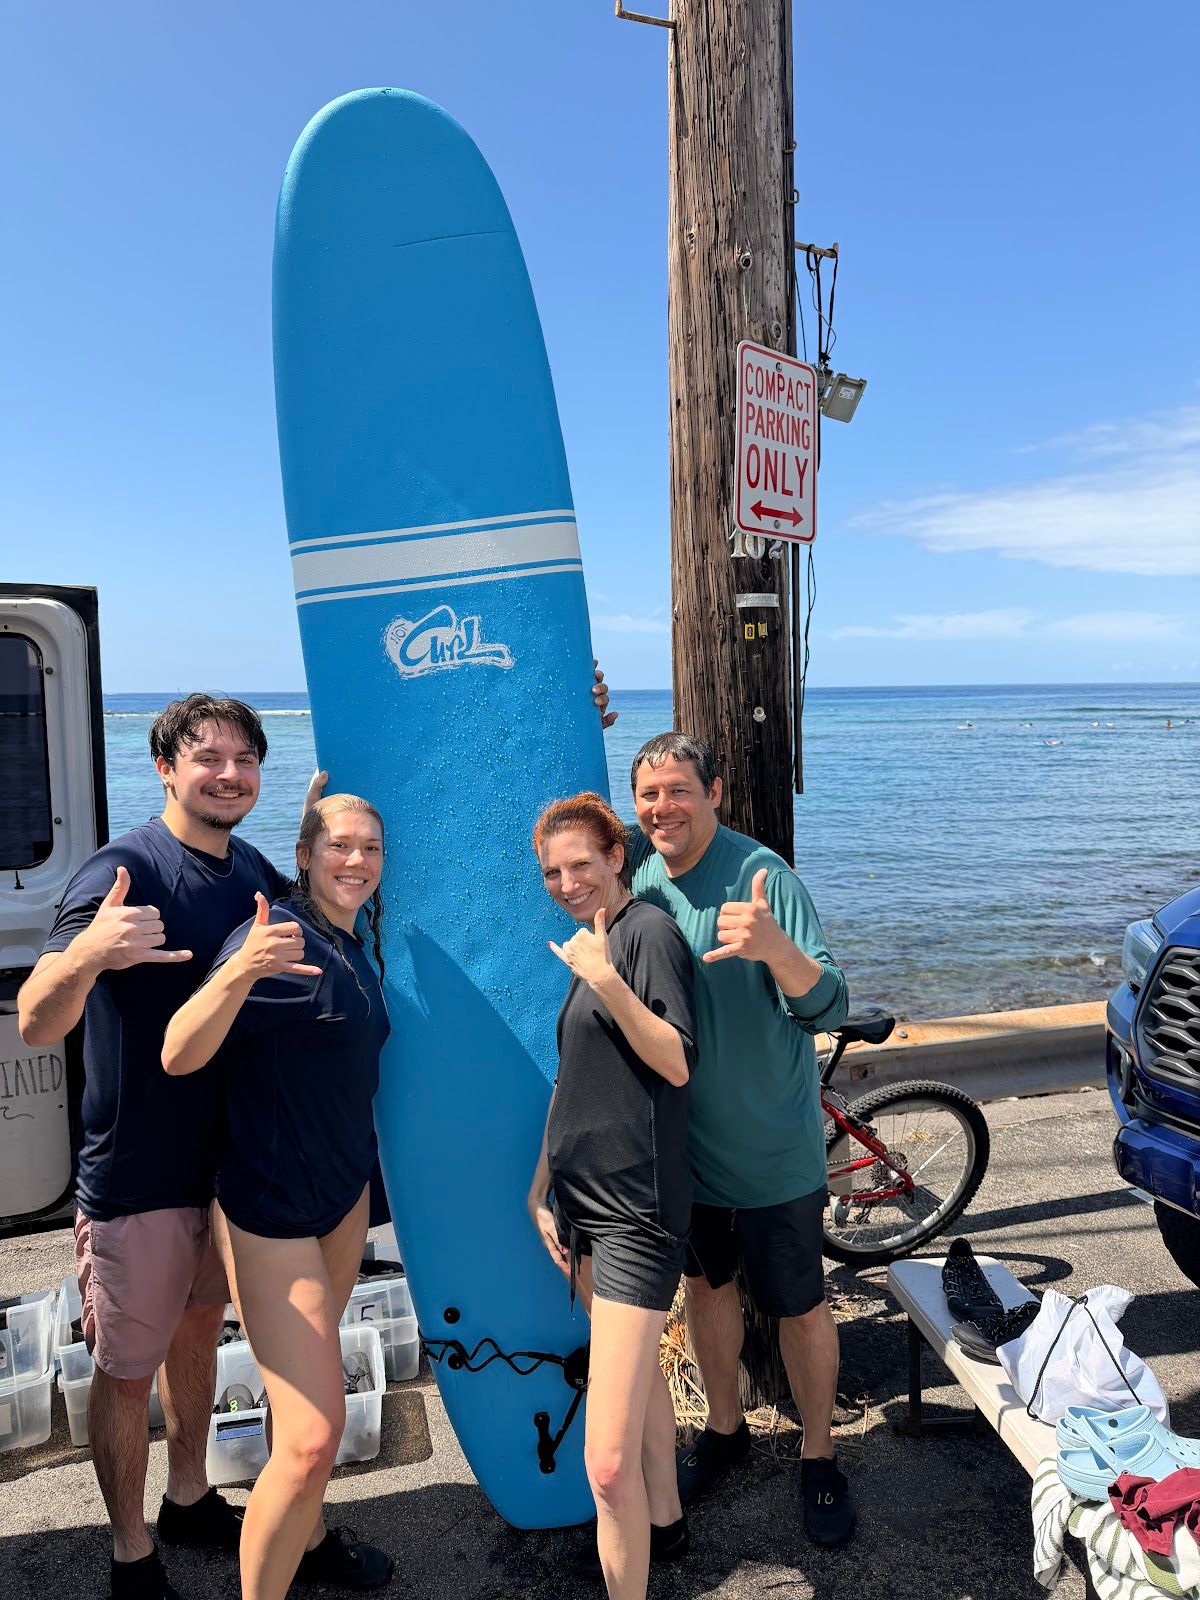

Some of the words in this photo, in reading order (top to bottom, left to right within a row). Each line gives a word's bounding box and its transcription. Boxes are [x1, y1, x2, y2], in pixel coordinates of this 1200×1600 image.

[745, 362, 811, 413] COMPACT
[745, 402, 811, 451] PARKING
[746, 443, 808, 499] ONLY
[229, 1399, 239, 1413] 8
[817, 1492, 834, 1506] 10
